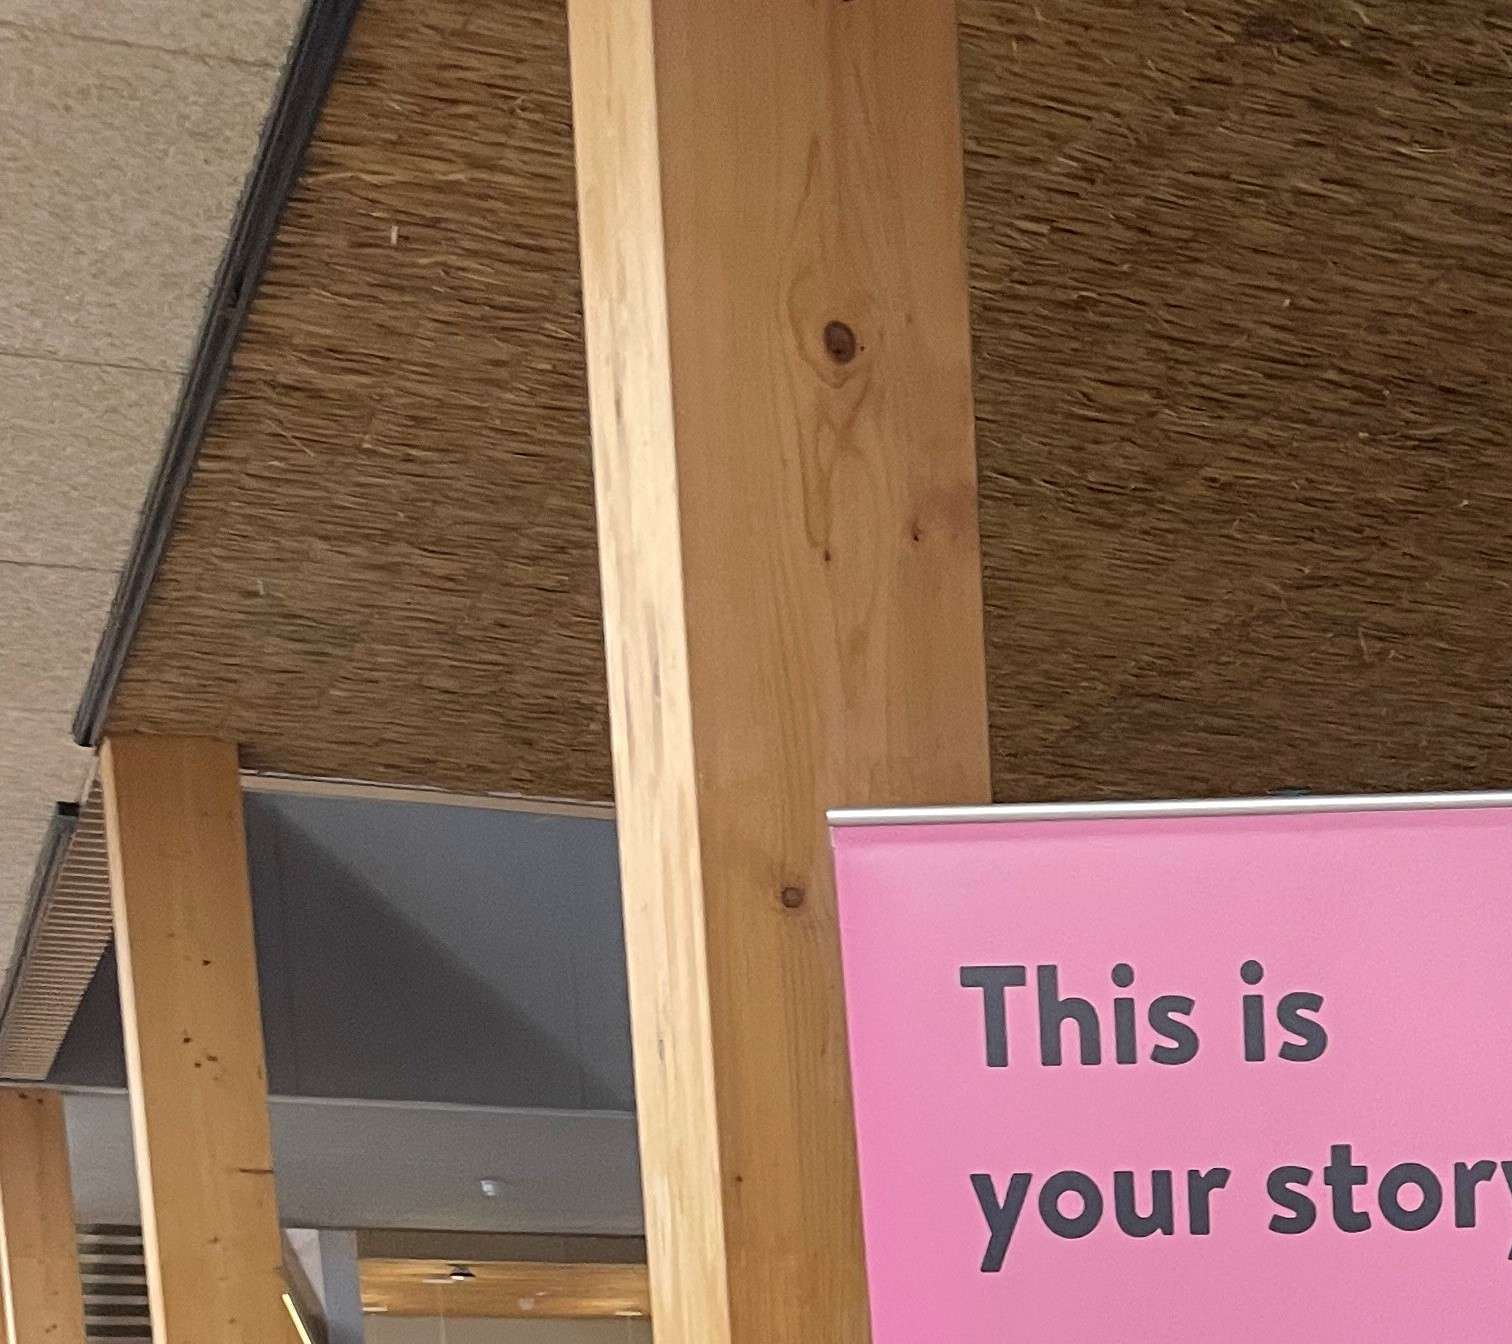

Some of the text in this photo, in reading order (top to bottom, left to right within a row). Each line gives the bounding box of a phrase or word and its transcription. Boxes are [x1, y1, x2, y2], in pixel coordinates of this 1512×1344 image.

[960, 959, 1329, 1067] This is
[970, 1166, 1230, 1273] your
